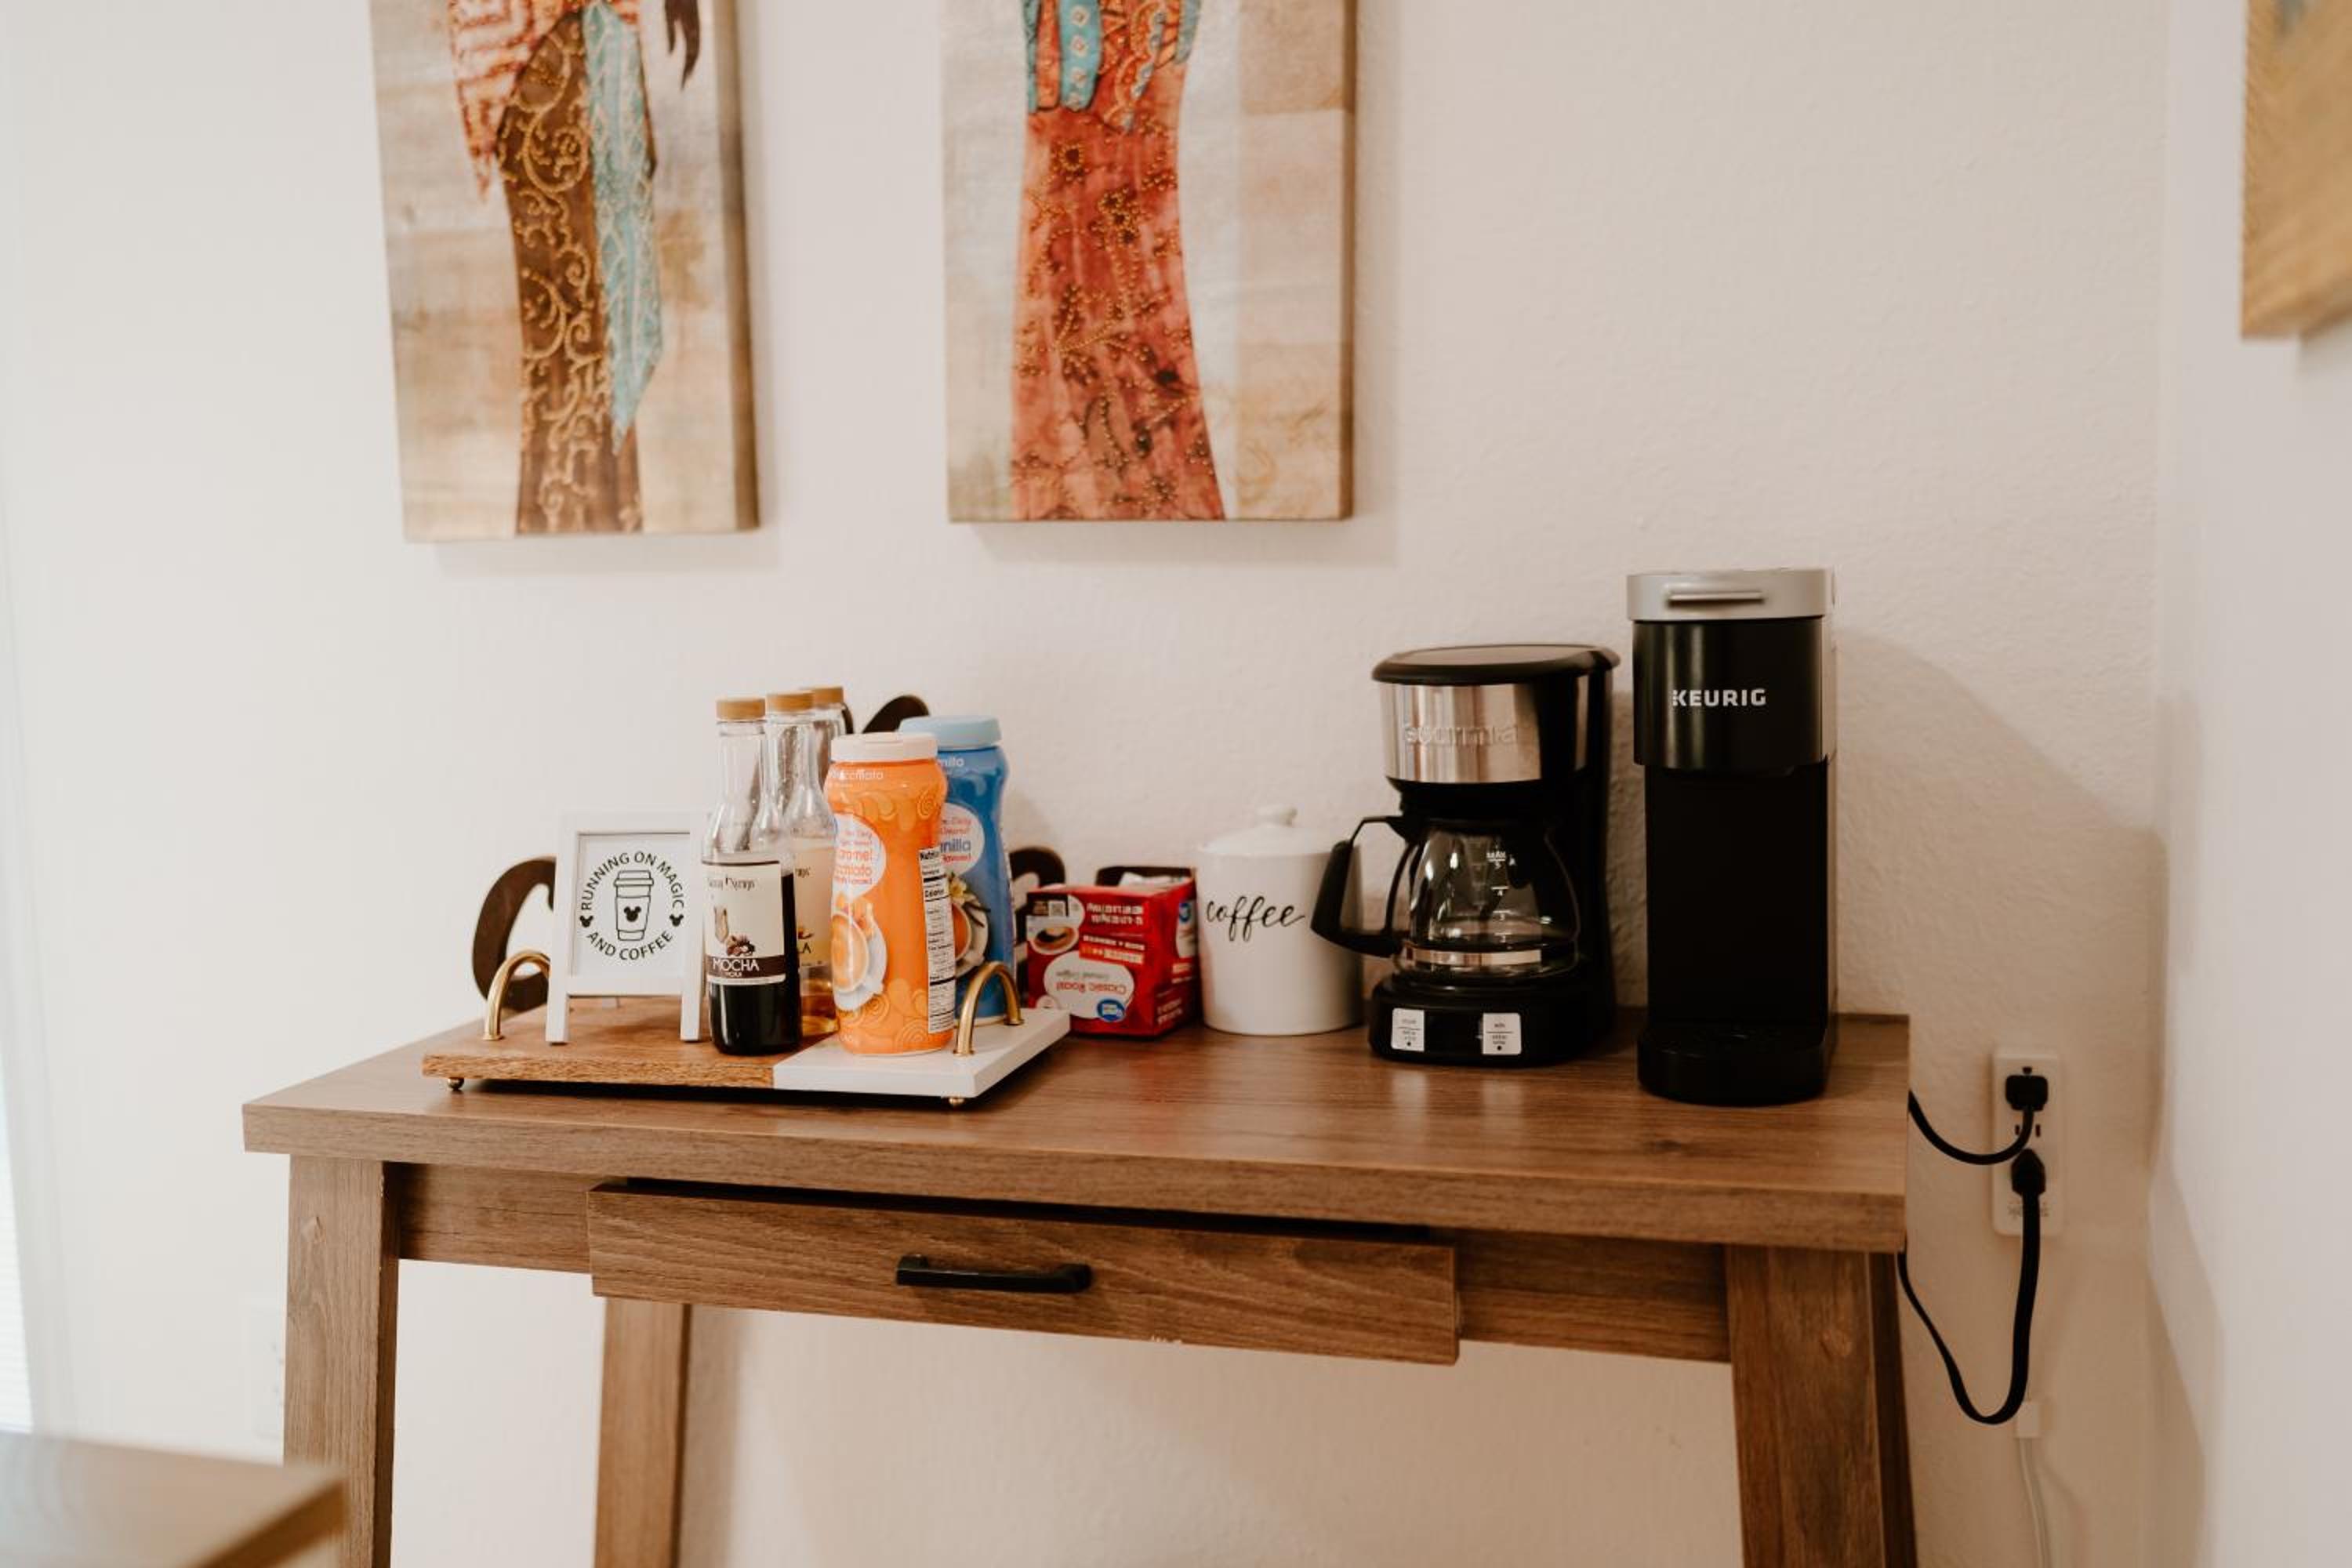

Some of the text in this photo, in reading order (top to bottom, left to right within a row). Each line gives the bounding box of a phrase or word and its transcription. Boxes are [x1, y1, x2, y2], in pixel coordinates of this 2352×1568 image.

[1672, 688, 1766, 706] KEURIG
[581, 851, 684, 911] RUNNING ON MAGIC
[1207, 895, 1305, 942] coffee
[586, 931, 673, 960] AND COFFEE
[713, 957, 760, 972] MOCHA
